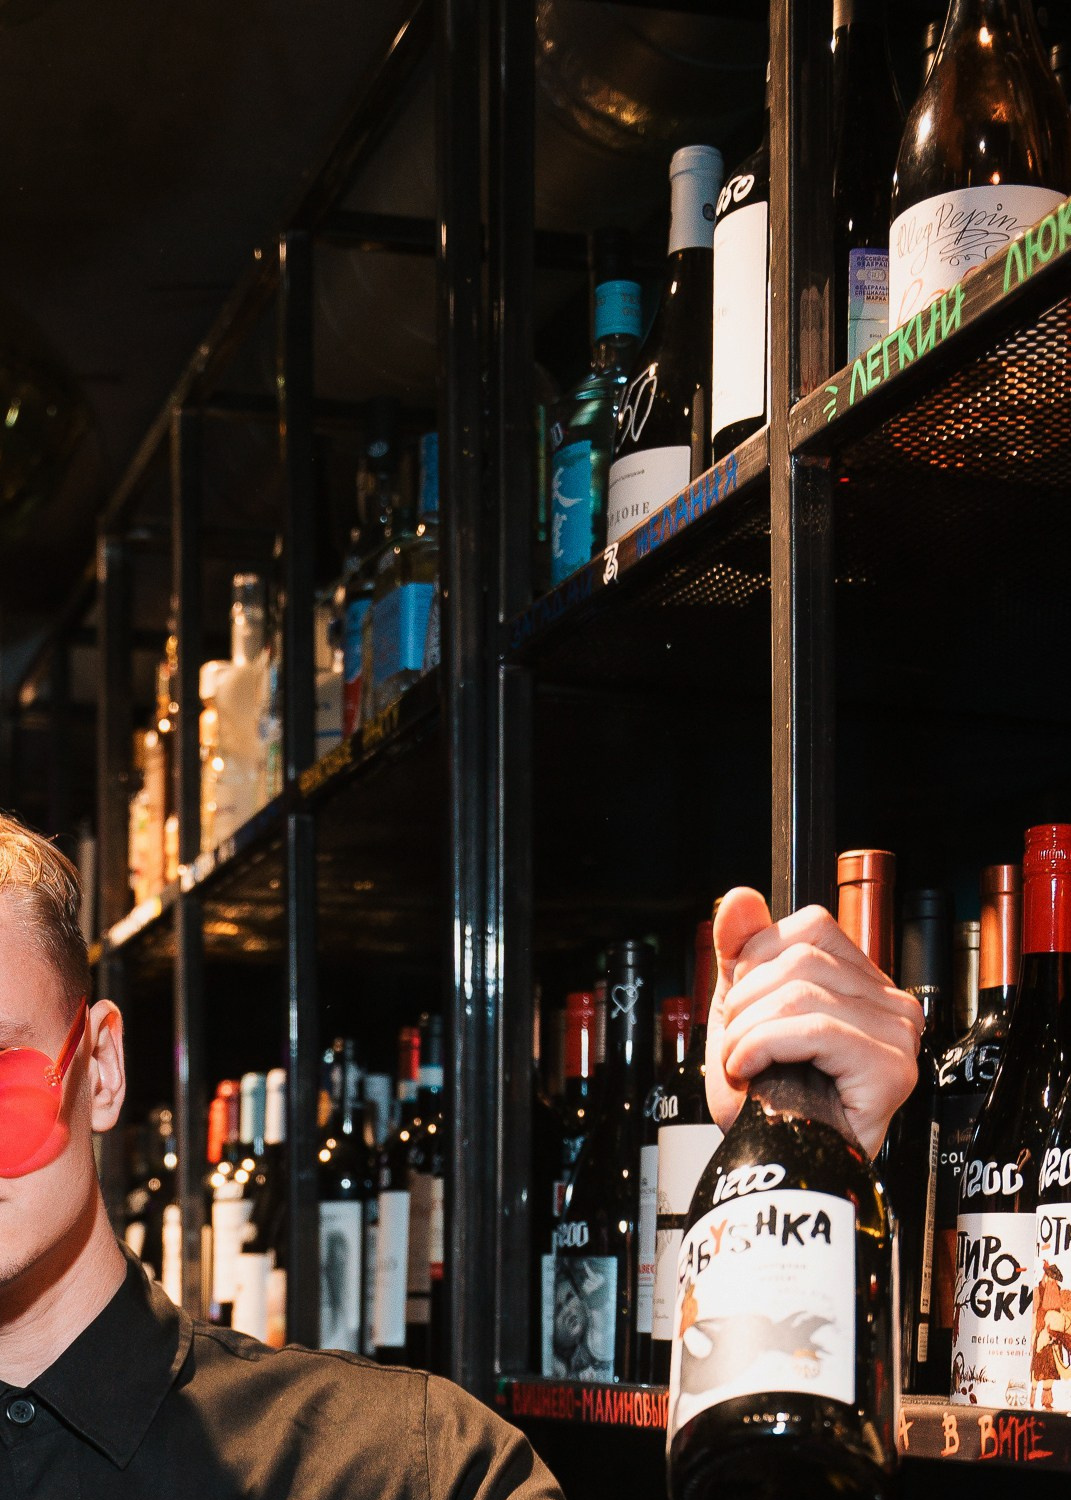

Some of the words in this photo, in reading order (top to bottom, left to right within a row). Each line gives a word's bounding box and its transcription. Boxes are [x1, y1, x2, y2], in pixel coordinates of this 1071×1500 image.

[935, 202, 1033, 246] Repin
[849, 283, 966, 406] ЛЕГКИЙ
[940, 1411, 960, 1457] В
[978, 1414, 1054, 1461] ВИНЕ
